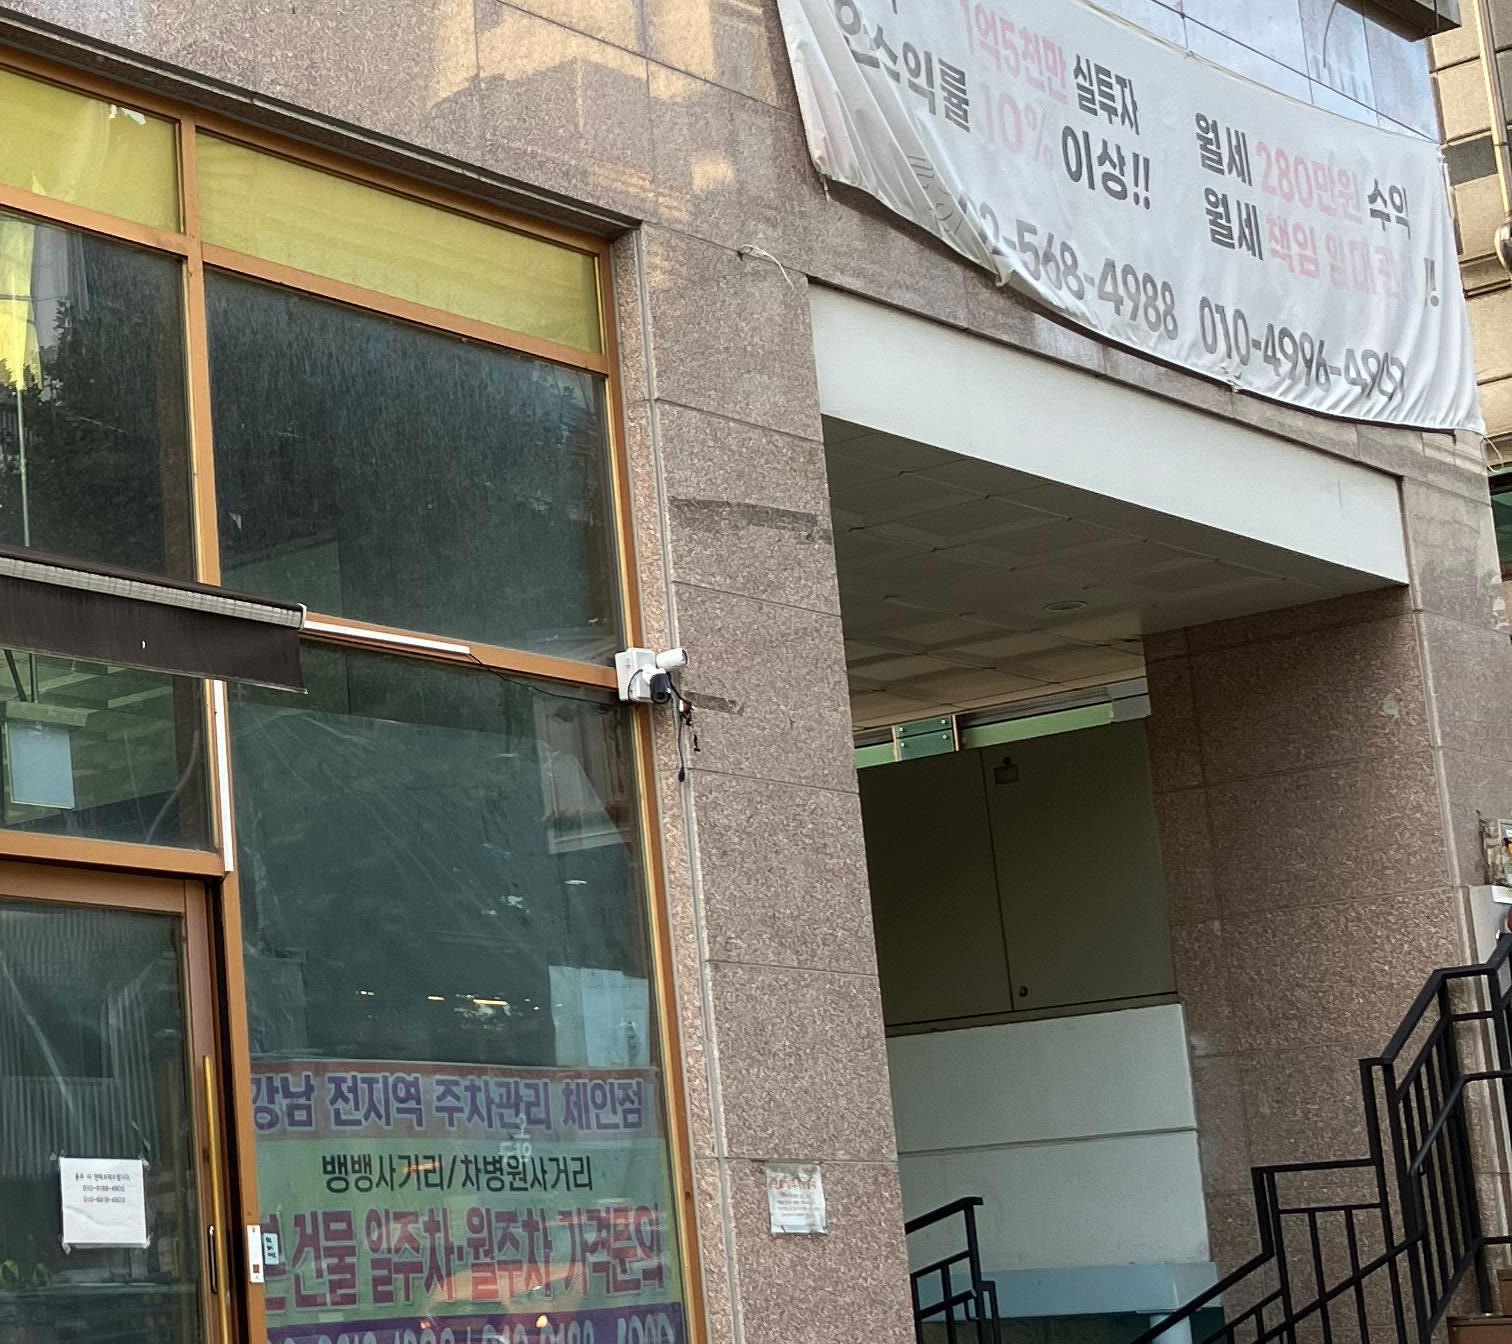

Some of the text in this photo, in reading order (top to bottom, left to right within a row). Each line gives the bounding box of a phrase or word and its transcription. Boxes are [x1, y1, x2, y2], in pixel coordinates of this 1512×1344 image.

[1071, 53, 1141, 136] 실투자
[978, 79, 1054, 173] 10%
[1061, 123, 1151, 210] 이상!!
[1194, 112, 1412, 241] 월세 280만원 수익
[1203, 187, 1321, 281] 월세 책임
[251, 1072, 644, 1131] 강남 전지역 주차관리 체인점
